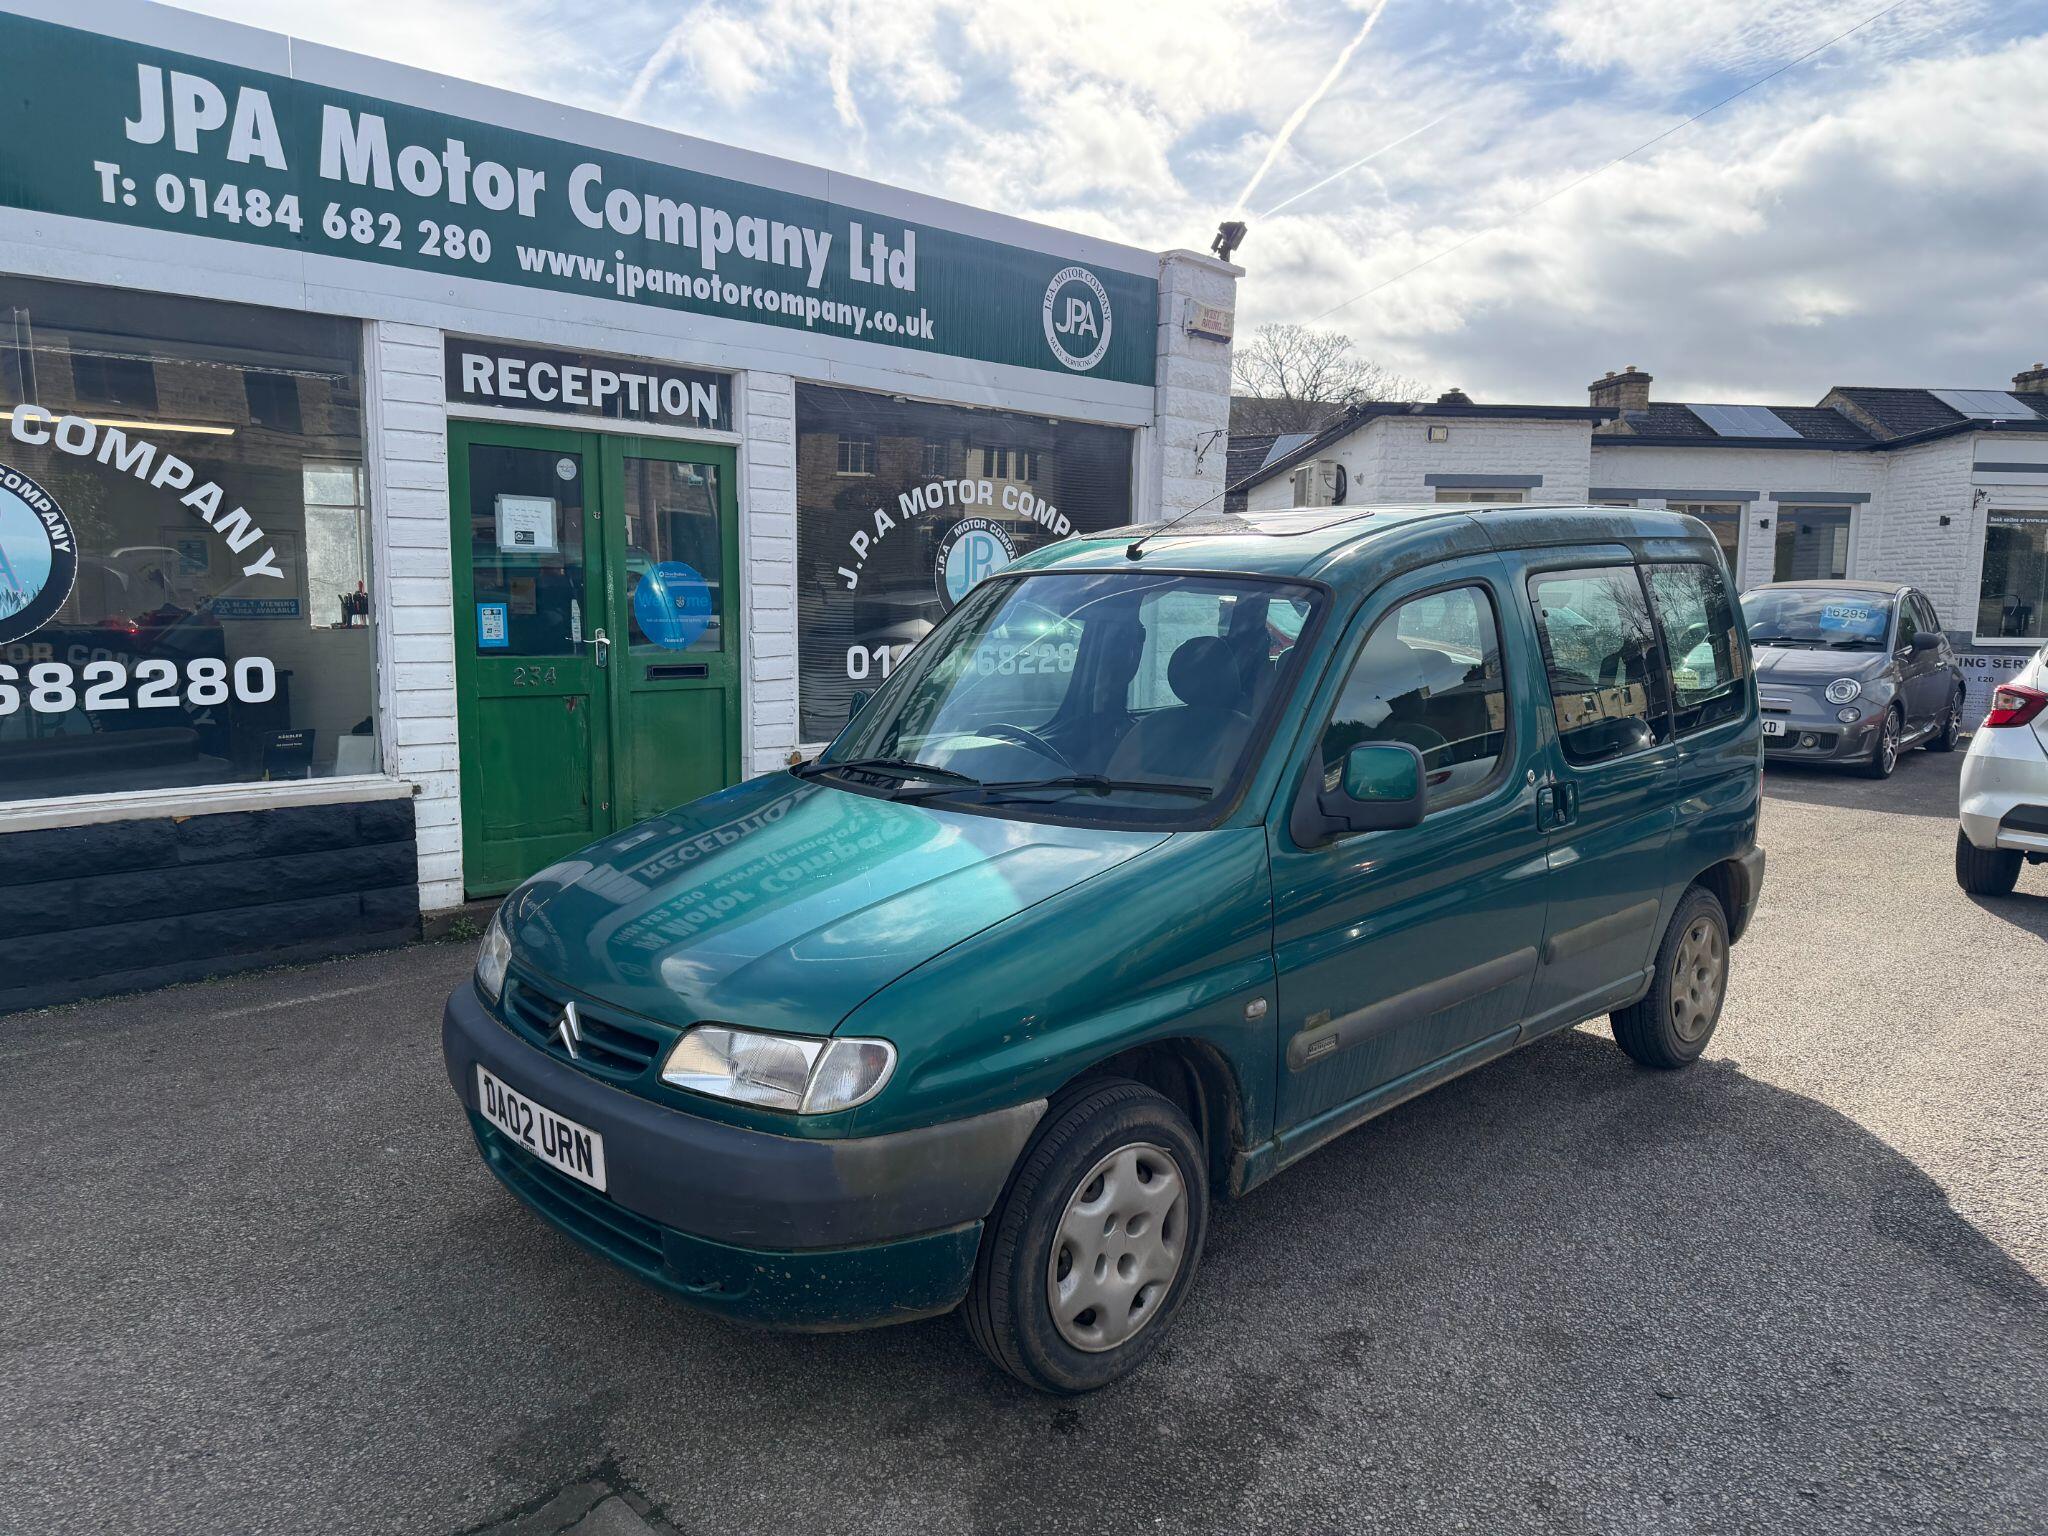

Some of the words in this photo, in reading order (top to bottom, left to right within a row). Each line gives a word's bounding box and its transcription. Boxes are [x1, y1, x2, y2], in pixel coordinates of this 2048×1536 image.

[125, 63, 288, 170] JPA
[320, 104, 545, 218] Motor
[568, 163, 832, 288] Company
[849, 221, 916, 292] Ltd
[94, 160, 137, 207] T:
[155, 173, 303, 233] 01484
[322, 202, 402, 251] 682
[418, 219, 492, 264] 280
[516, 249, 934, 340] www.jpamotorcompany.co.uk
[1055, 268, 1084, 286] MOTOR
[1085, 273, 1111, 322] COMPANY
[1055, 297, 1099, 339] JPA
[462, 353, 718, 420] RECEPTION
[11, 403, 284, 580] COMPANY
[837, 508, 896, 590] J.P.A
[898, 479, 993, 519] MOTOR
[1002, 486, 1080, 539] COMP
[954, 520, 987, 537] MOTOR
[989, 524, 1018, 564] COMPA
[512, 666, 557, 688] 234
[977, 643, 1076, 676] 68228
[1955, 657, 1987, 669] ING
[484, 1074, 536, 1147] DA02
[539, 1112, 594, 1179] URN
